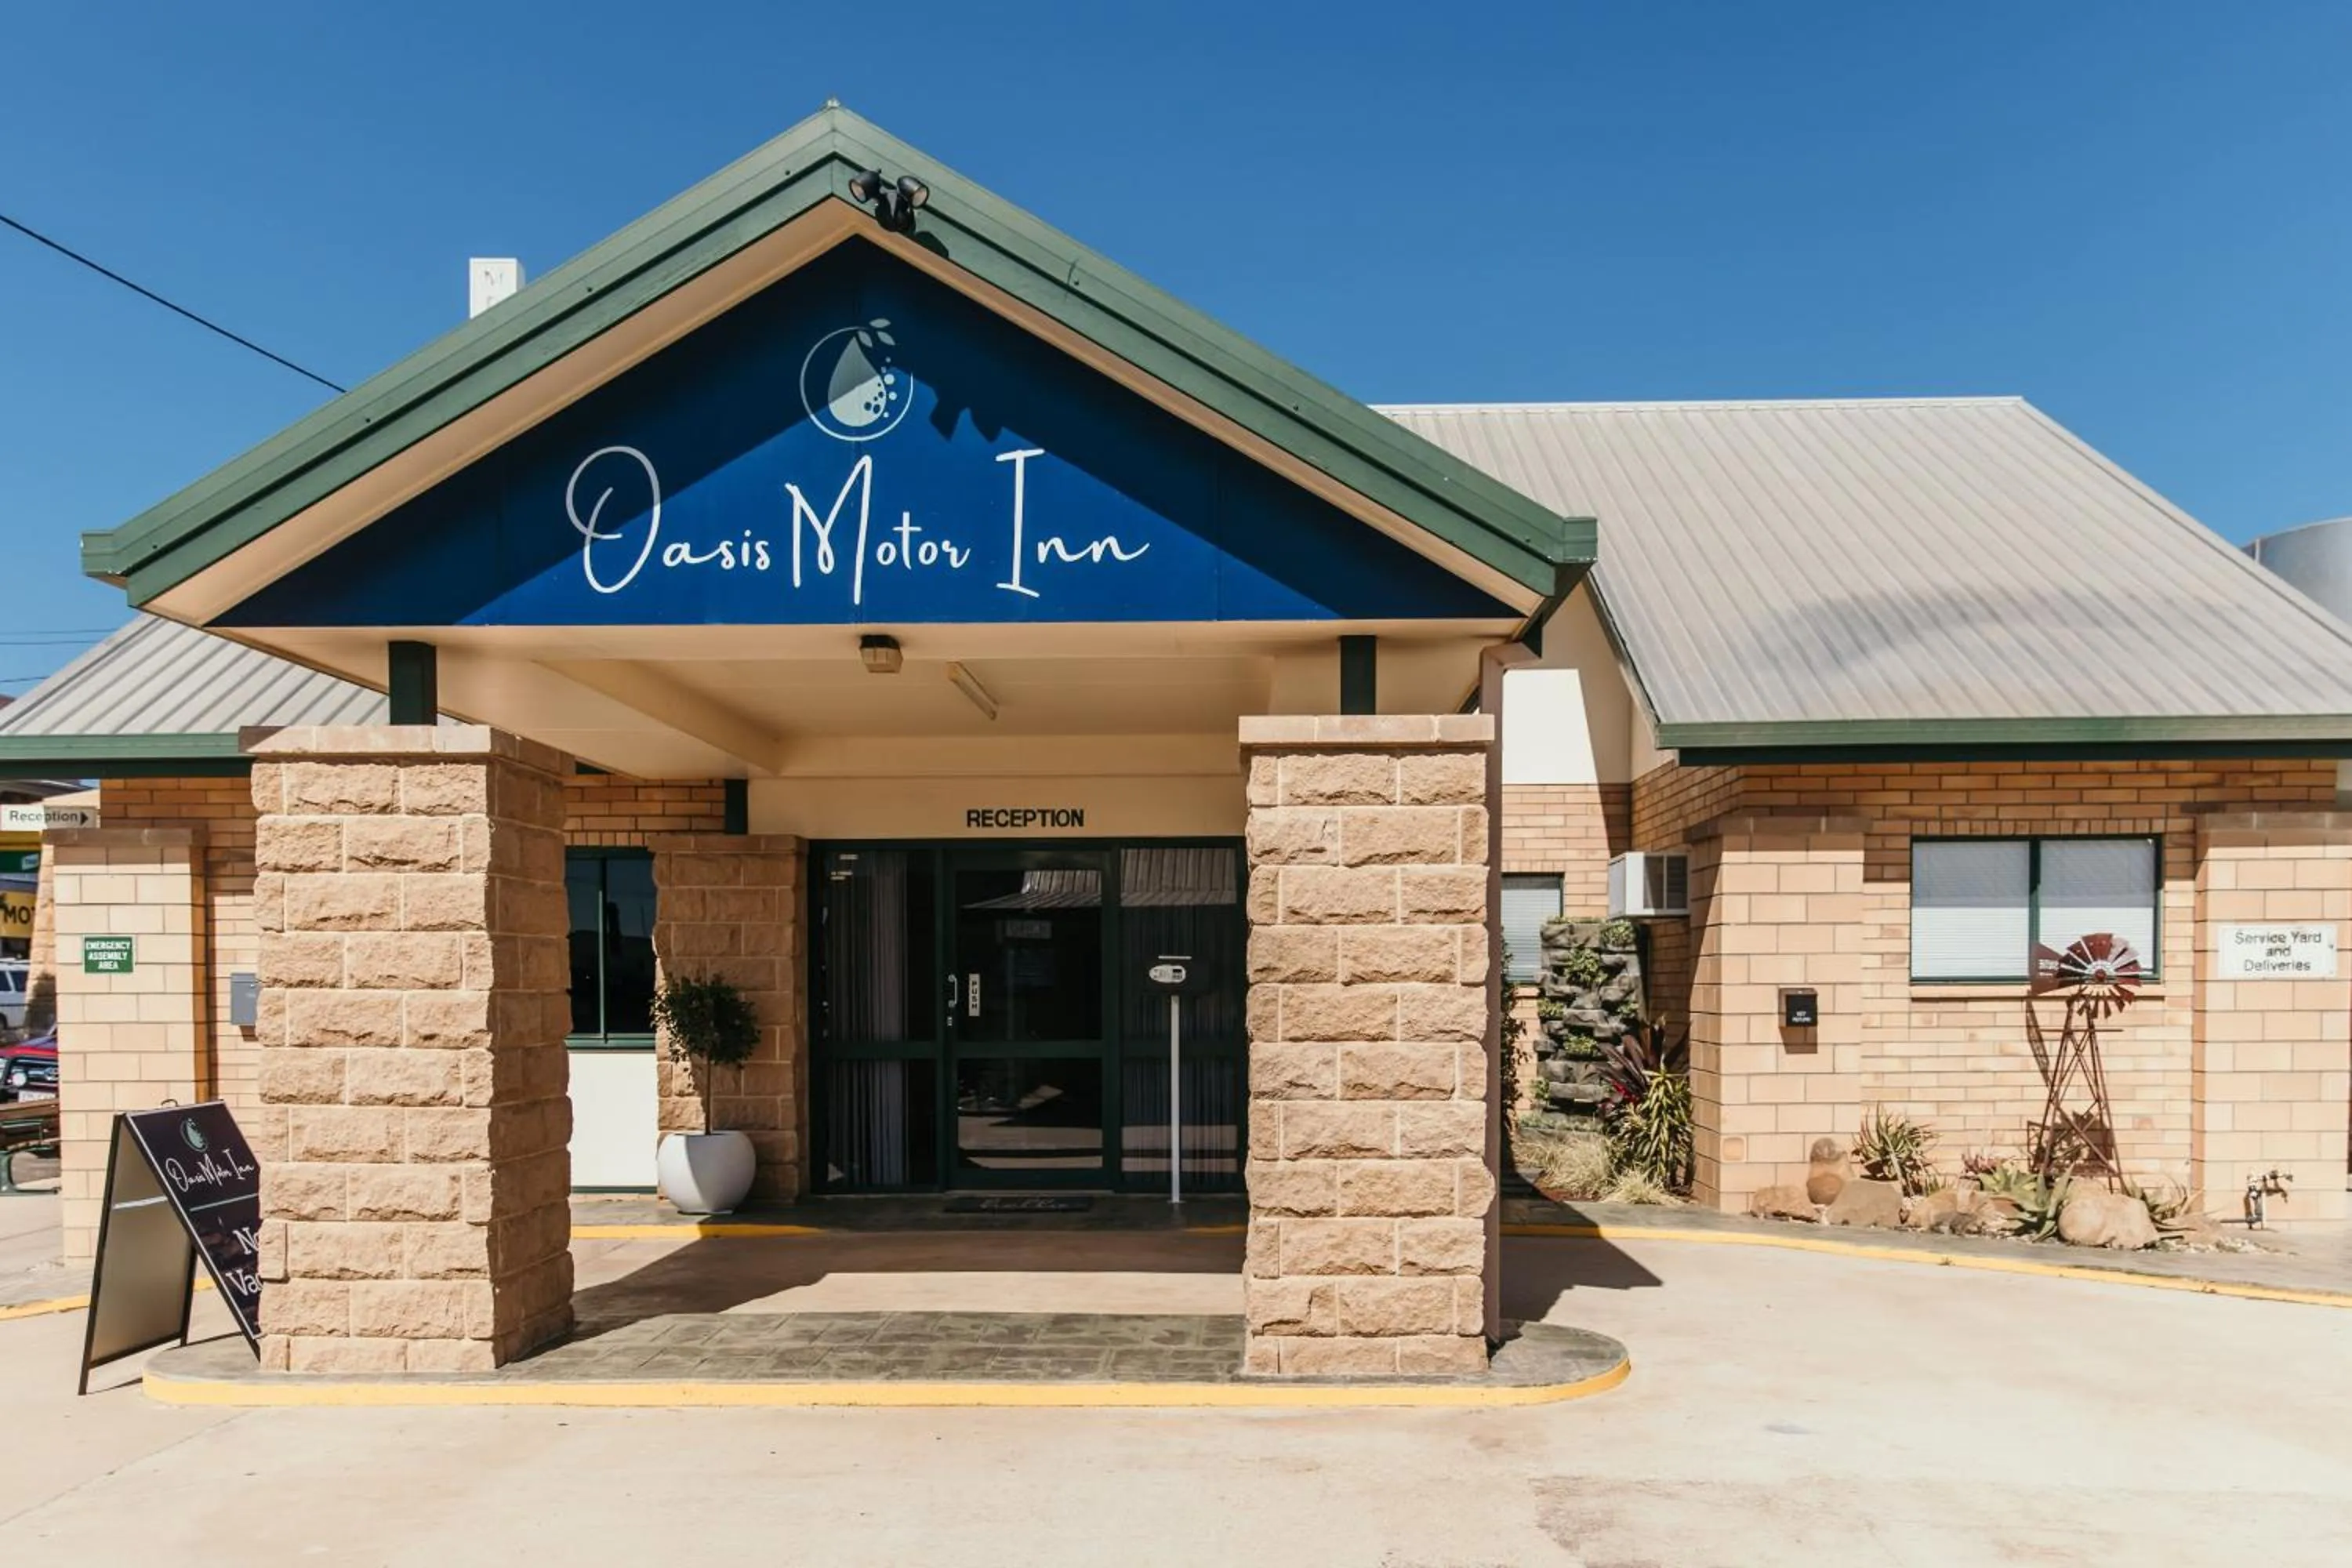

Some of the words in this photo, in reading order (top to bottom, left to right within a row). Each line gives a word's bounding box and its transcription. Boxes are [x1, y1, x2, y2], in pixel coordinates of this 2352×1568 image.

[565, 445, 771, 594] Oasis
[785, 454, 971, 606] Motor
[996, 448, 1150, 598] Inn
[9, 810, 78, 822] Reception
[967, 809, 1084, 828] RECEPTION
[3, 905, 36, 924] MO
[2235, 931, 2287, 945] Service
[2291, 931, 2321, 944] Yard
[86, 941, 130, 950] EMERGENCY
[2266, 946, 2292, 957] and
[88, 951, 127, 960] ASSEMBLY
[98, 961, 119, 970] AREA
[2245, 959, 2311, 971] Deliveries
